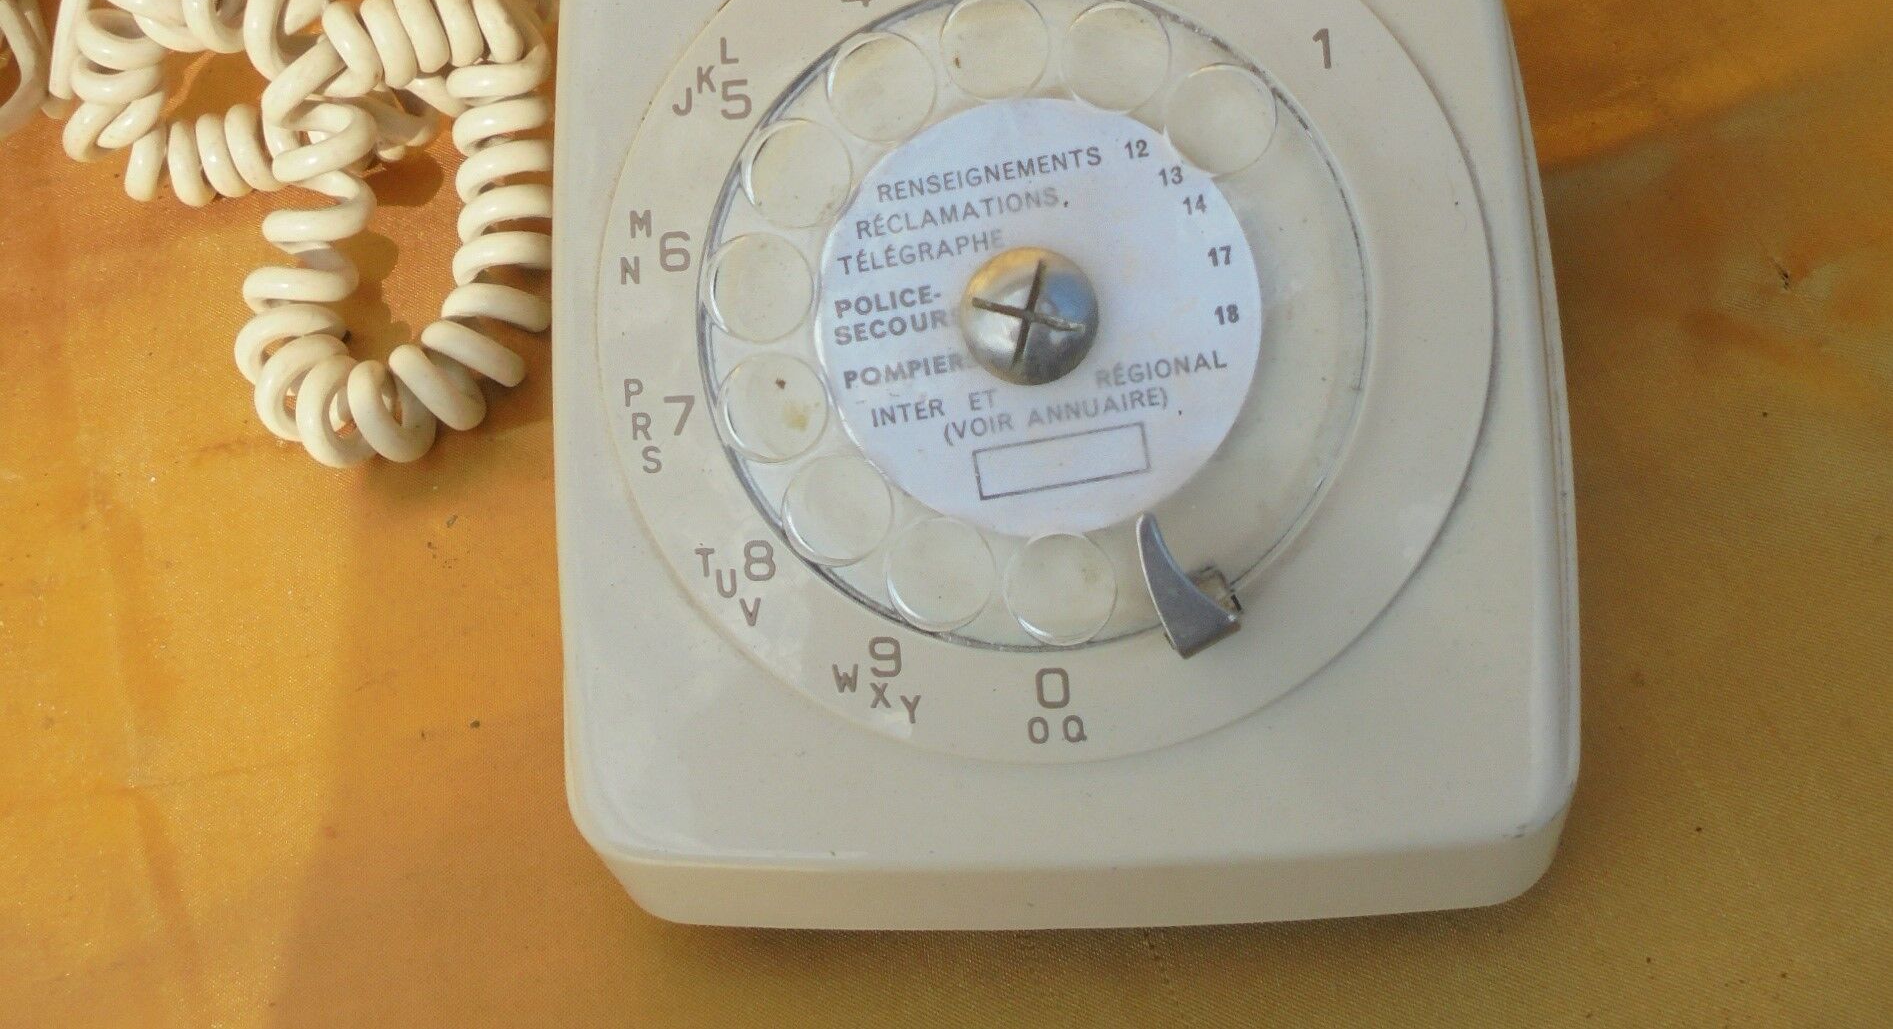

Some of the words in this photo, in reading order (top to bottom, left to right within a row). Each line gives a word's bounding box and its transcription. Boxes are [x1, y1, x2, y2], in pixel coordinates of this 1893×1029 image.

[1312, 27, 1334, 70] 1
[719, 79, 752, 120] 5
[878, 146, 1102, 203] RENSEIGNEMENTS
[1124, 139, 1150, 159] 12
[1158, 166, 1184, 187] 13
[659, 231, 691, 272] 6
[838, 229, 1004, 276] TÉLÉGRAPHE
[1182, 194, 1207, 215] 14
[834, 286, 942, 319] POLICE-
[1207, 246, 1232, 268] 17
[1215, 305, 1239, 326] 18
[871, 398, 944, 428] INTER
[969, 389, 997, 412] ET
[1095, 349, 1228, 388] RÉGIONAL
[664, 395, 695, 436] 7
[943, 413, 1015, 446] (VOIR
[1027, 385, 1169, 426] ANNUAIRE)
[743, 540, 776, 581] 8
[868, 636, 902, 678] 9
[1036, 667, 1070, 709] 0
